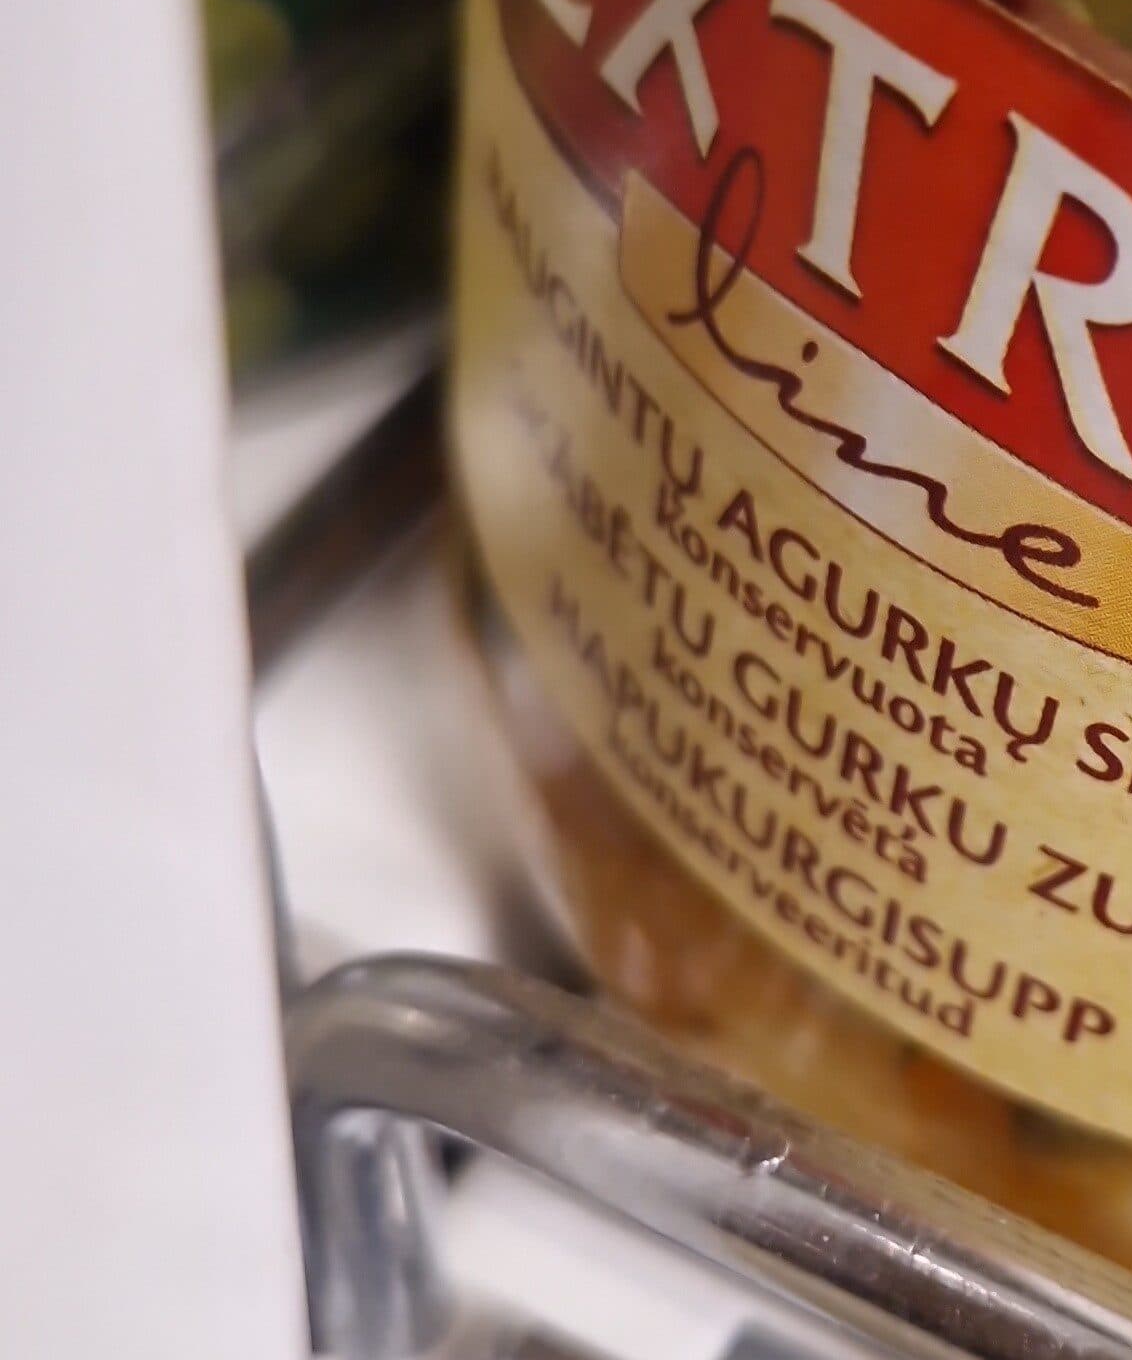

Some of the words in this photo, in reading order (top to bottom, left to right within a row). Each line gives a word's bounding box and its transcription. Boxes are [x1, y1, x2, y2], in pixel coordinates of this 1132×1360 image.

[668, 146, 1098, 608] line
[656, 478, 988, 778] konservuota
[716, 488, 1060, 764] AGURKŲ
